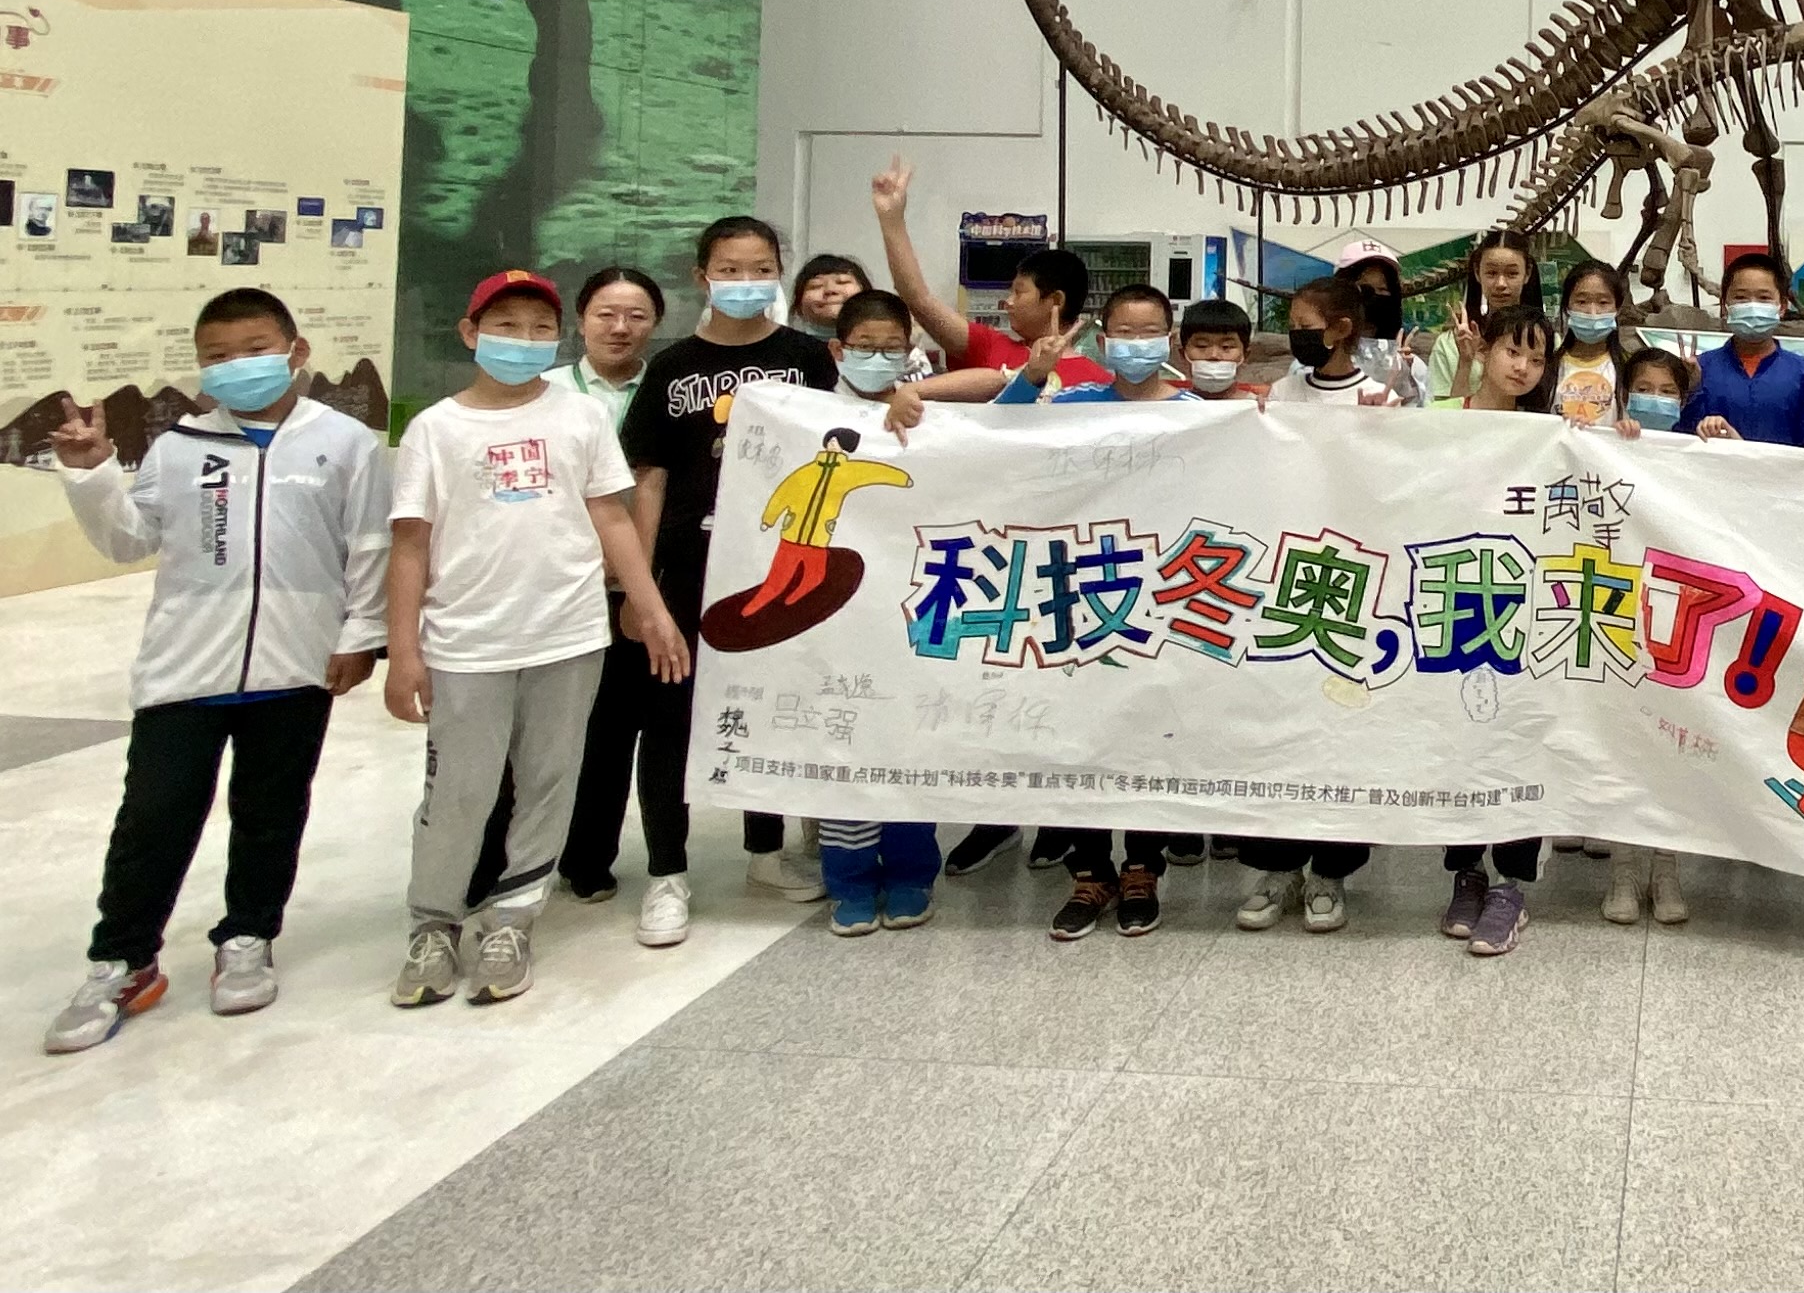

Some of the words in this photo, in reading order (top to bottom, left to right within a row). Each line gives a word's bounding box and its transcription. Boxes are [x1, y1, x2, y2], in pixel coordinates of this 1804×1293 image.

[493, 441, 541, 466] 中国
[494, 467, 544, 488] 李宁
[214, 488, 229, 567] NORTHLAND
